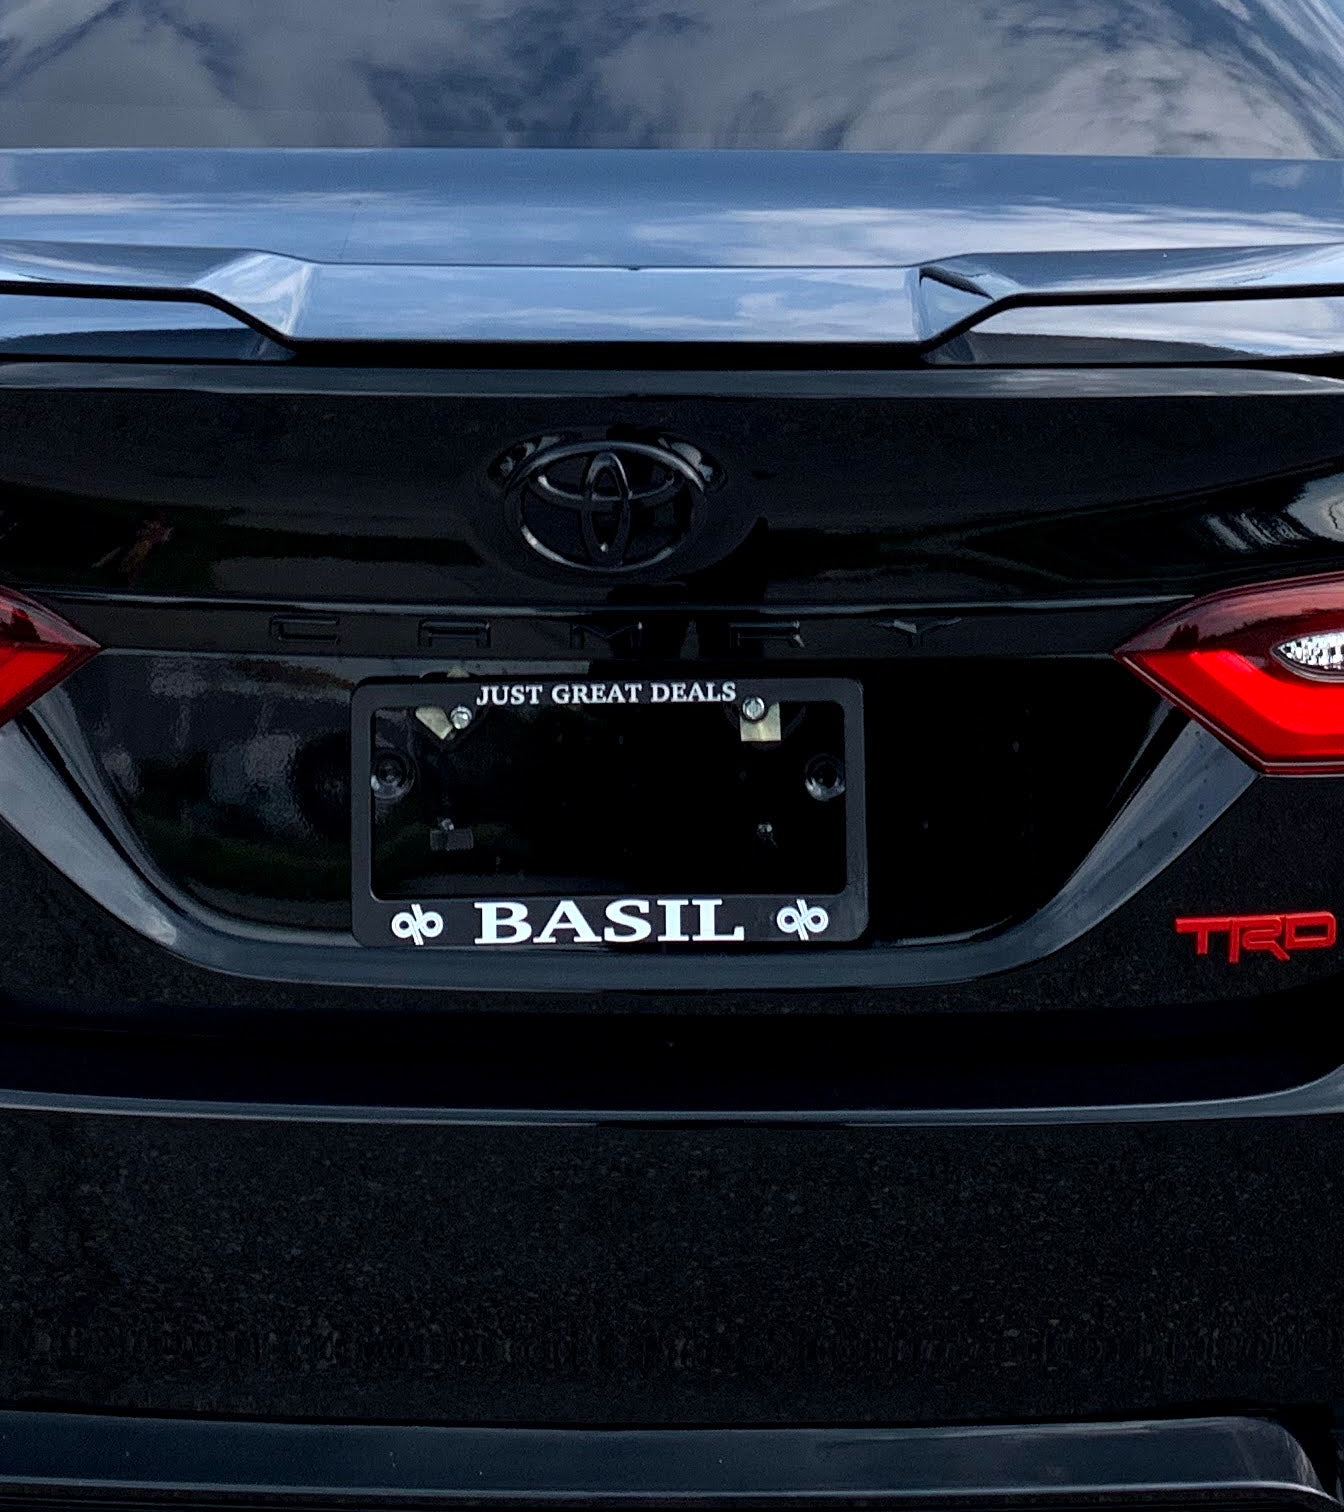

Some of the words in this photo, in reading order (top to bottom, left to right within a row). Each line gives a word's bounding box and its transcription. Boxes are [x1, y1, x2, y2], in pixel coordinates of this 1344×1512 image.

[476, 685, 543, 706] JUST
[551, 683, 642, 704] GREAT
[650, 682, 736, 703] DEALS
[473, 898, 745, 945] BASIL
[1175, 911, 1337, 963] TRD
